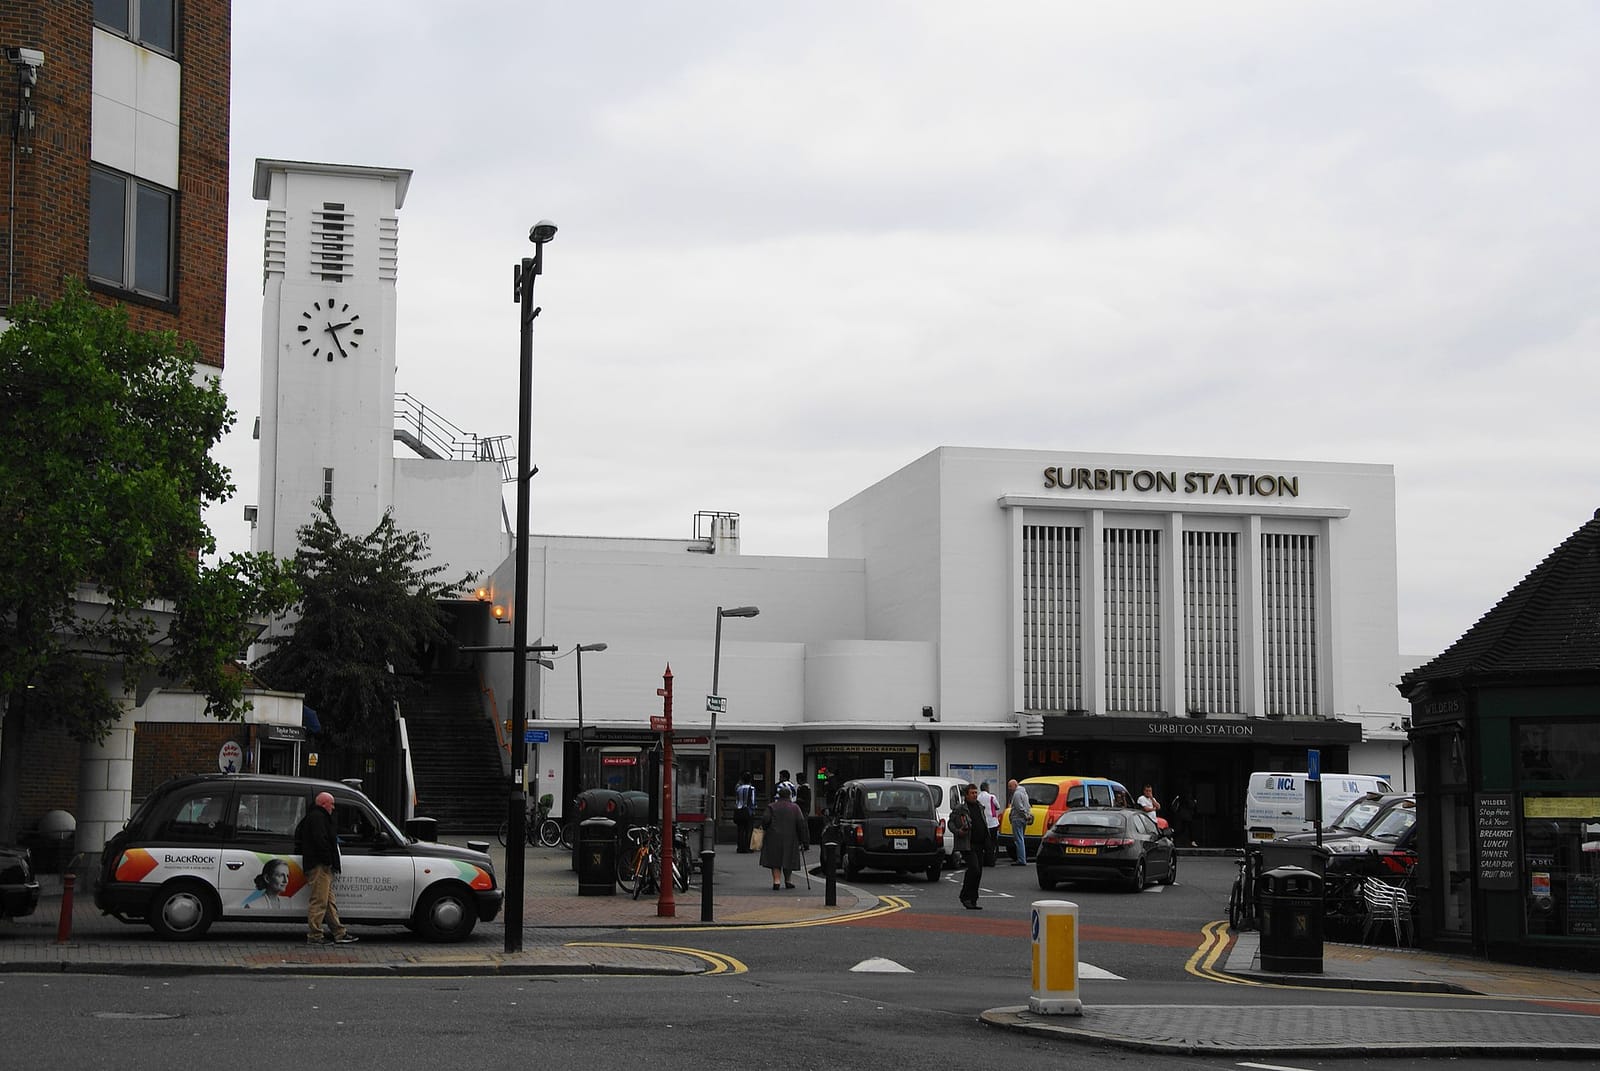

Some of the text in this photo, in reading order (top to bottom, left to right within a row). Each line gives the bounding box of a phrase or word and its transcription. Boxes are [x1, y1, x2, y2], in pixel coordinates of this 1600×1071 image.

[1043, 466, 1299, 498] SURBITON STATION
[1148, 723, 1253, 735] SURBITON STATION
[1277, 778, 1296, 791] NCL
[1480, 808, 1510, 817] Stop Here
[1479, 818, 1509, 826] Pick Your
[1479, 830, 1514, 838] BREAKFAST
[1483, 840, 1508, 848] LUNCH
[1481, 850, 1509, 858] DINNER
[1481, 870, 1513, 878] FRUIT BOX
